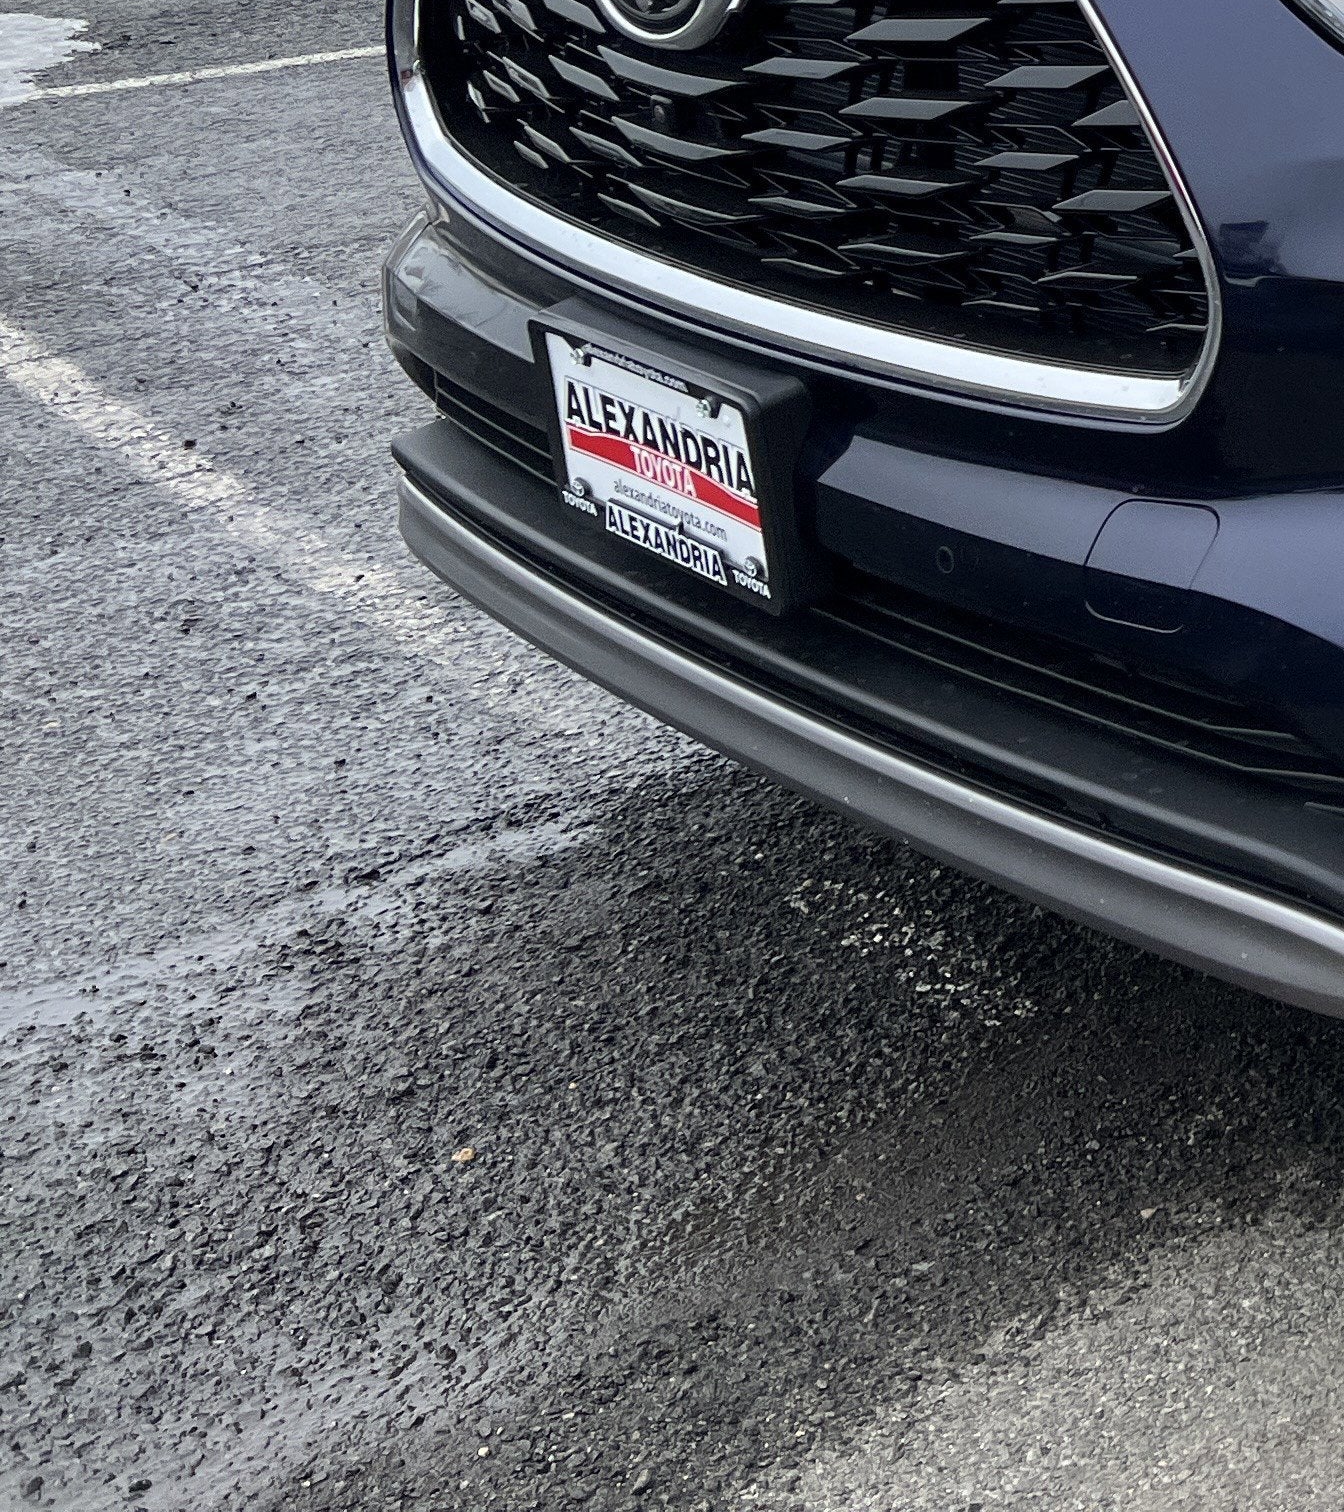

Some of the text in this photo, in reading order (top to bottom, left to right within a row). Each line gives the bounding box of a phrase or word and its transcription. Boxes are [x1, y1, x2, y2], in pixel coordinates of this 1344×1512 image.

[566, 381, 755, 495] ALEXANDRIA
[630, 445, 697, 498] TOYOTA
[562, 490, 598, 517] TOYOTA
[614, 479, 727, 543] alexandriatoyota.com
[607, 507, 727, 585] ALEXANDRIA
[732, 569, 771, 599] TOYOTA
